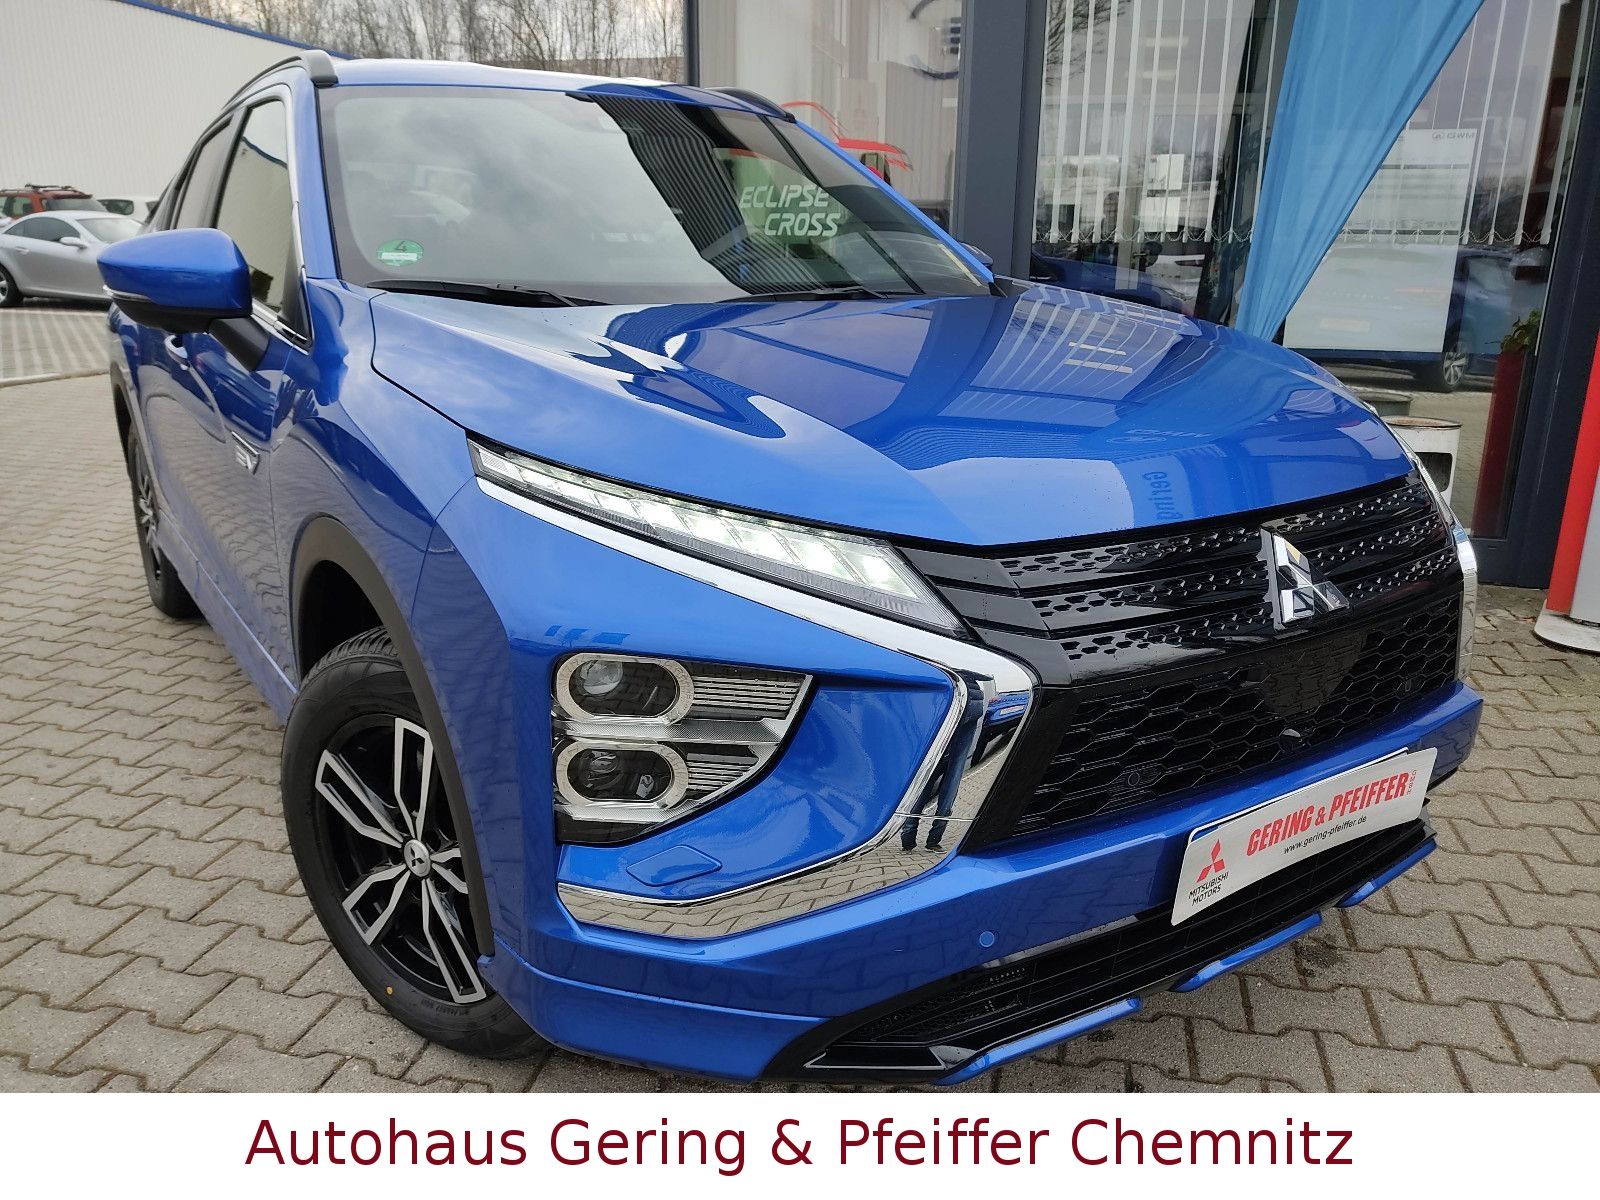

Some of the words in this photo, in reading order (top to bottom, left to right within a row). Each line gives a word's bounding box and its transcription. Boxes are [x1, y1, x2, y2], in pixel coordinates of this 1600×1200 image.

[739, 184, 830, 209] ECLIPSE
[764, 212, 841, 237] CROSS
[394, 240, 408, 253] 4
[1246, 805, 1315, 857] GERING
[1314, 806, 1326, 826] &
[1328, 772, 1409, 822] PFEIFFER
[1283, 815, 1367, 855] www.gering-pfeiffer.de
[1188, 871, 1229, 899] MITSUBISHI
[1191, 883, 1222, 907] MOTORS
